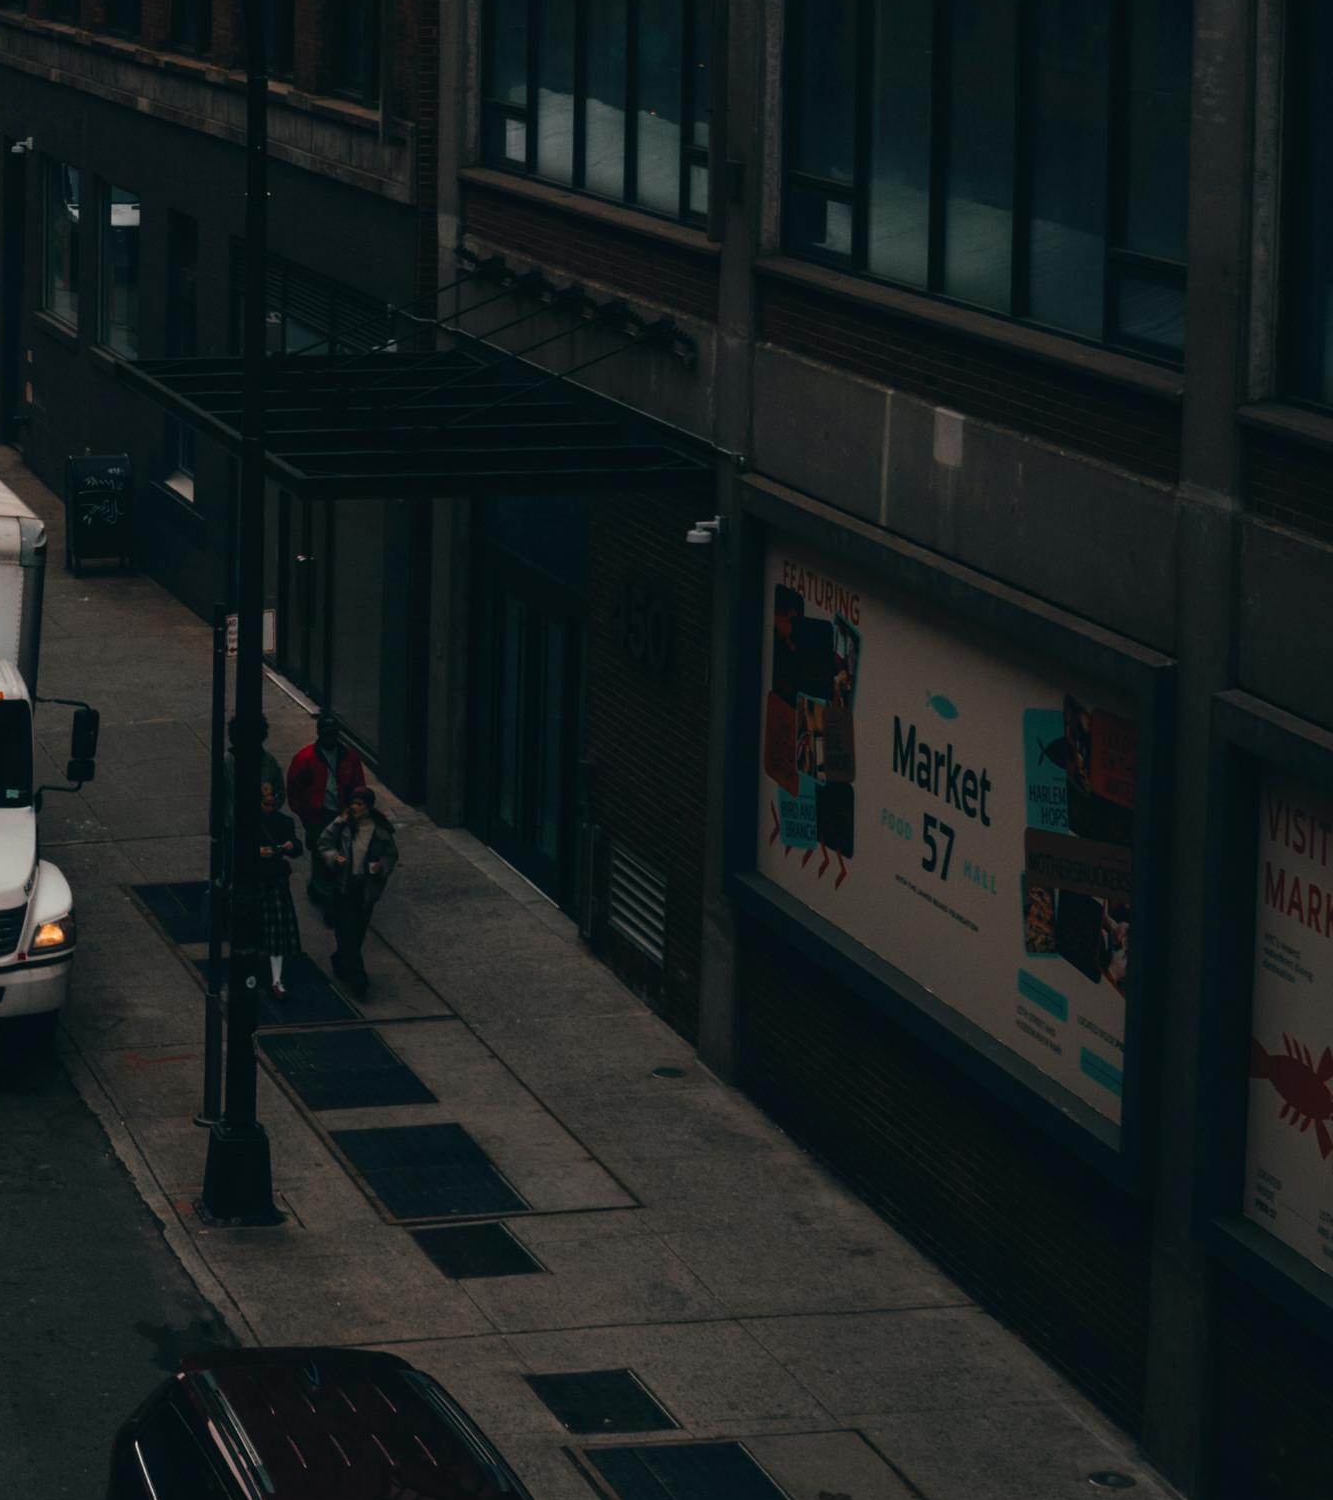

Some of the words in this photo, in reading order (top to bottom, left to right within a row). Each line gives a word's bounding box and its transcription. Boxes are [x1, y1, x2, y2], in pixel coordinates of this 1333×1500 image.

[783, 560, 860, 626] FEATURING
[892, 714, 992, 828] Market
[1029, 783, 1066, 806] HARLEM
[880, 807, 913, 841] FOOD
[1041, 806, 1068, 828] HOPS
[1267, 792, 1332, 867] VISIT
[921, 811, 956, 882] 57
[963, 858, 998, 896] HALL
